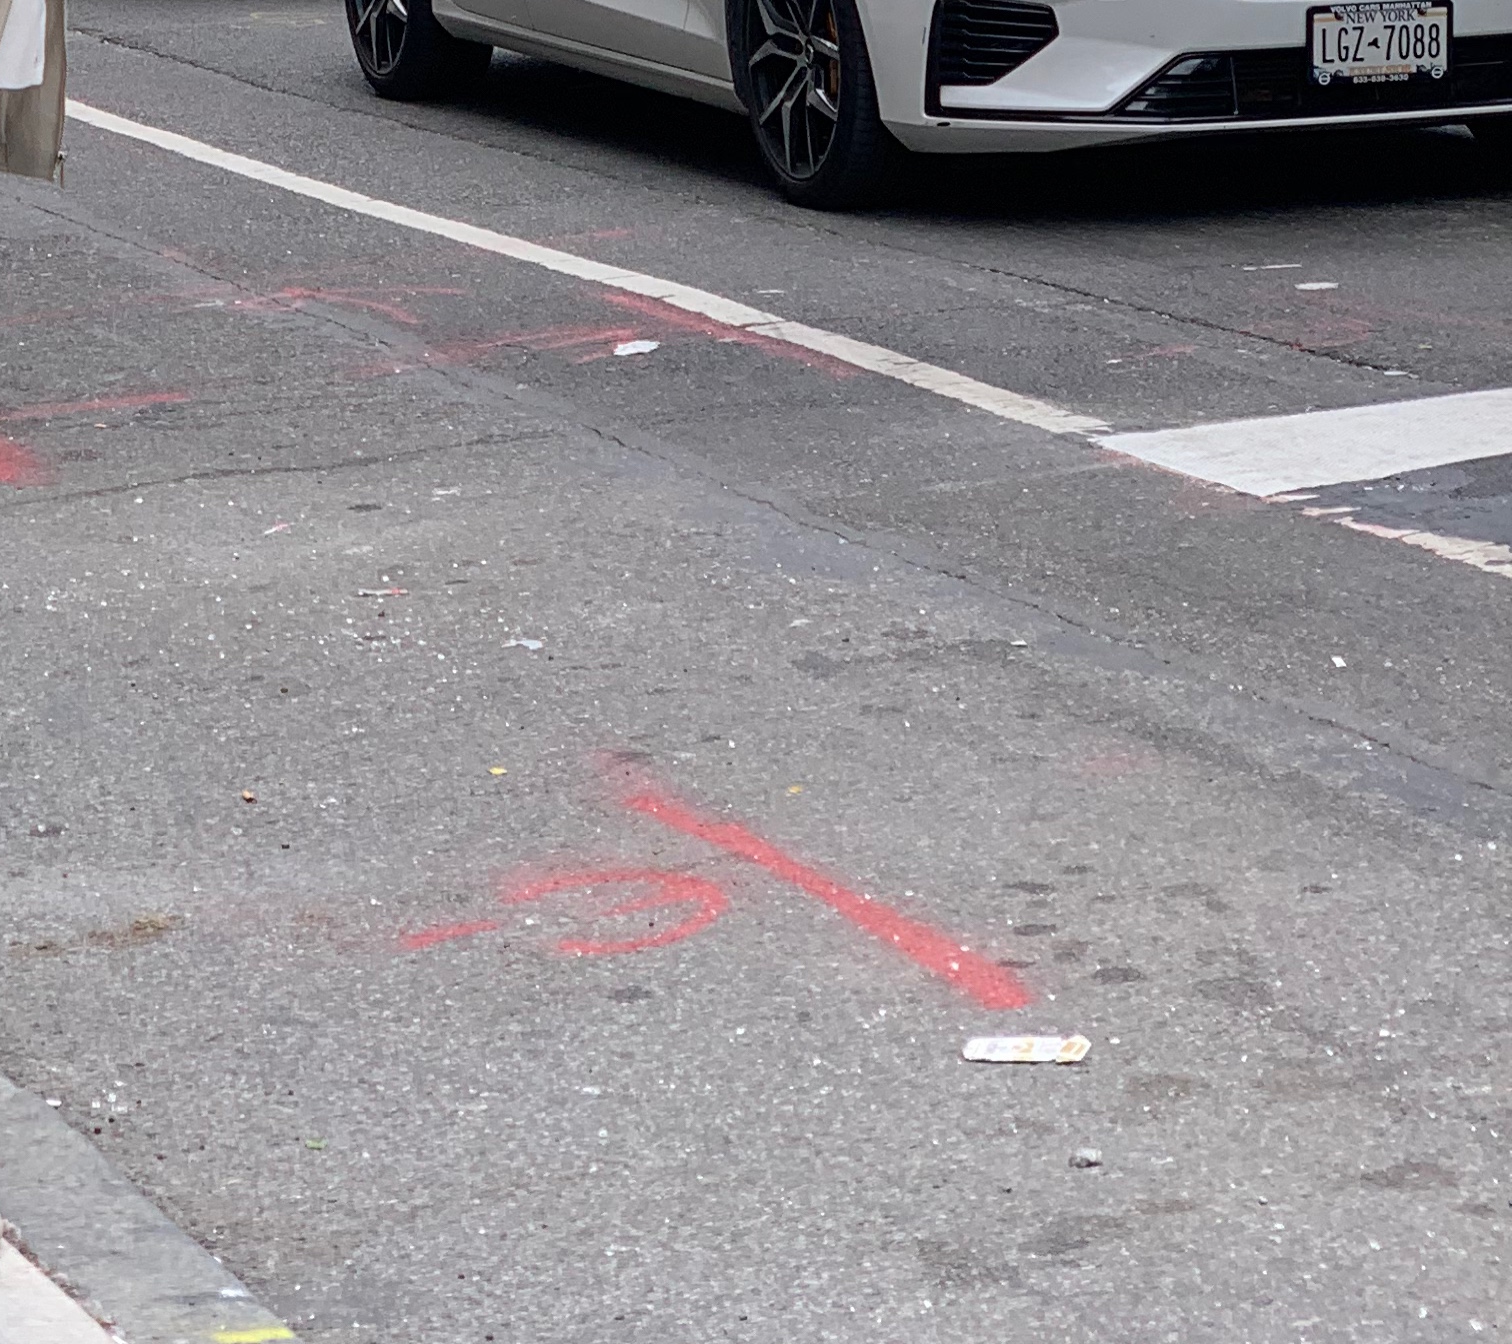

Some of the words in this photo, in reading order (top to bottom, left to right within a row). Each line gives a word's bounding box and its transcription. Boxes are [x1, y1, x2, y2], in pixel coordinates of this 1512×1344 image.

[1383, 1, 1432, 10] MANHATTAN
[1346, 11, 1378, 24] NEW
[1380, 9, 1417, 22] YORK
